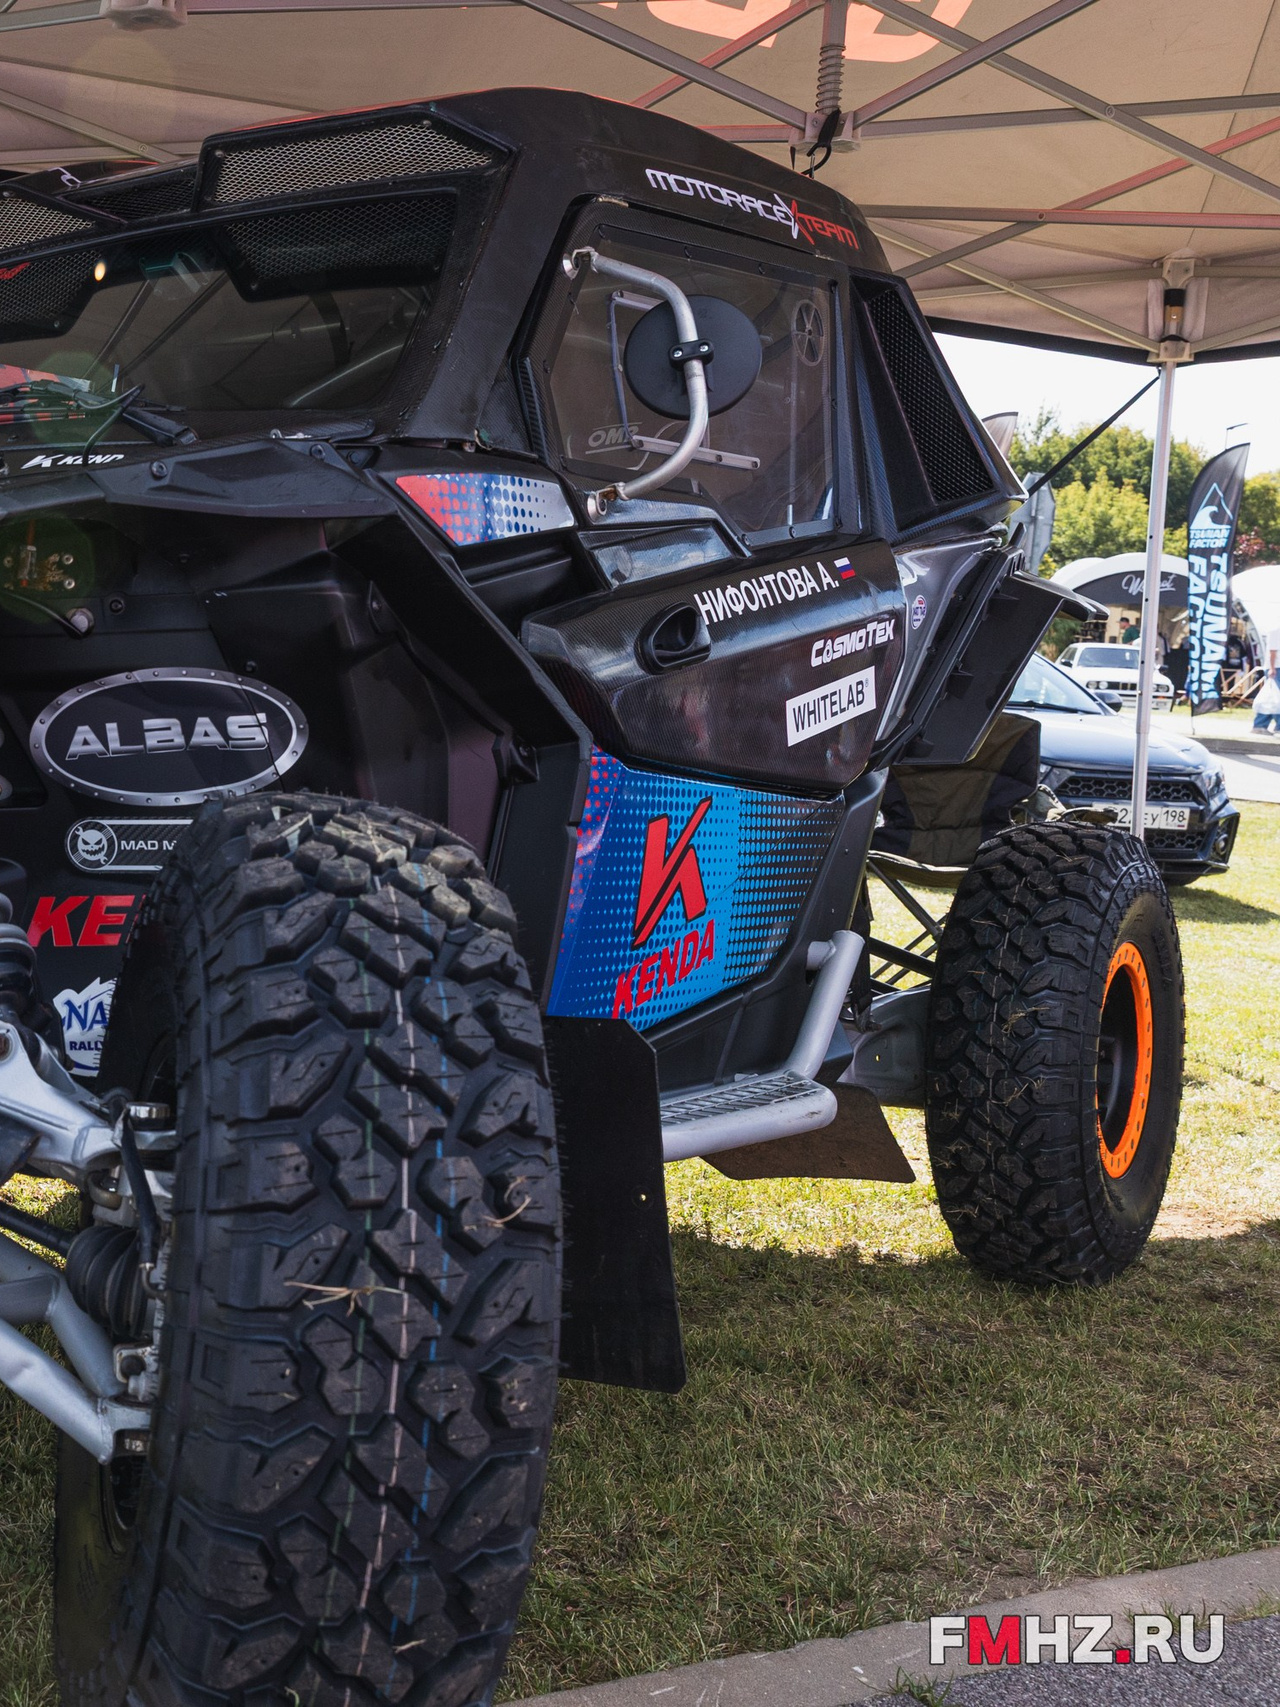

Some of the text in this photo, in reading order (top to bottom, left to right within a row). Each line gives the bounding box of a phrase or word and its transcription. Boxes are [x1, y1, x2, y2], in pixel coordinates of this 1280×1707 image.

[694, 561, 839, 626] НИФОНТОВА А.
[792, 679, 866, 733] WHITELAB
[65, 712, 269, 761] ALBAS
[1163, 809, 1185, 823] 198
[121, 840, 159, 850] MAD
[27, 894, 146, 947] KE
[612, 918, 715, 1020] KENDA
